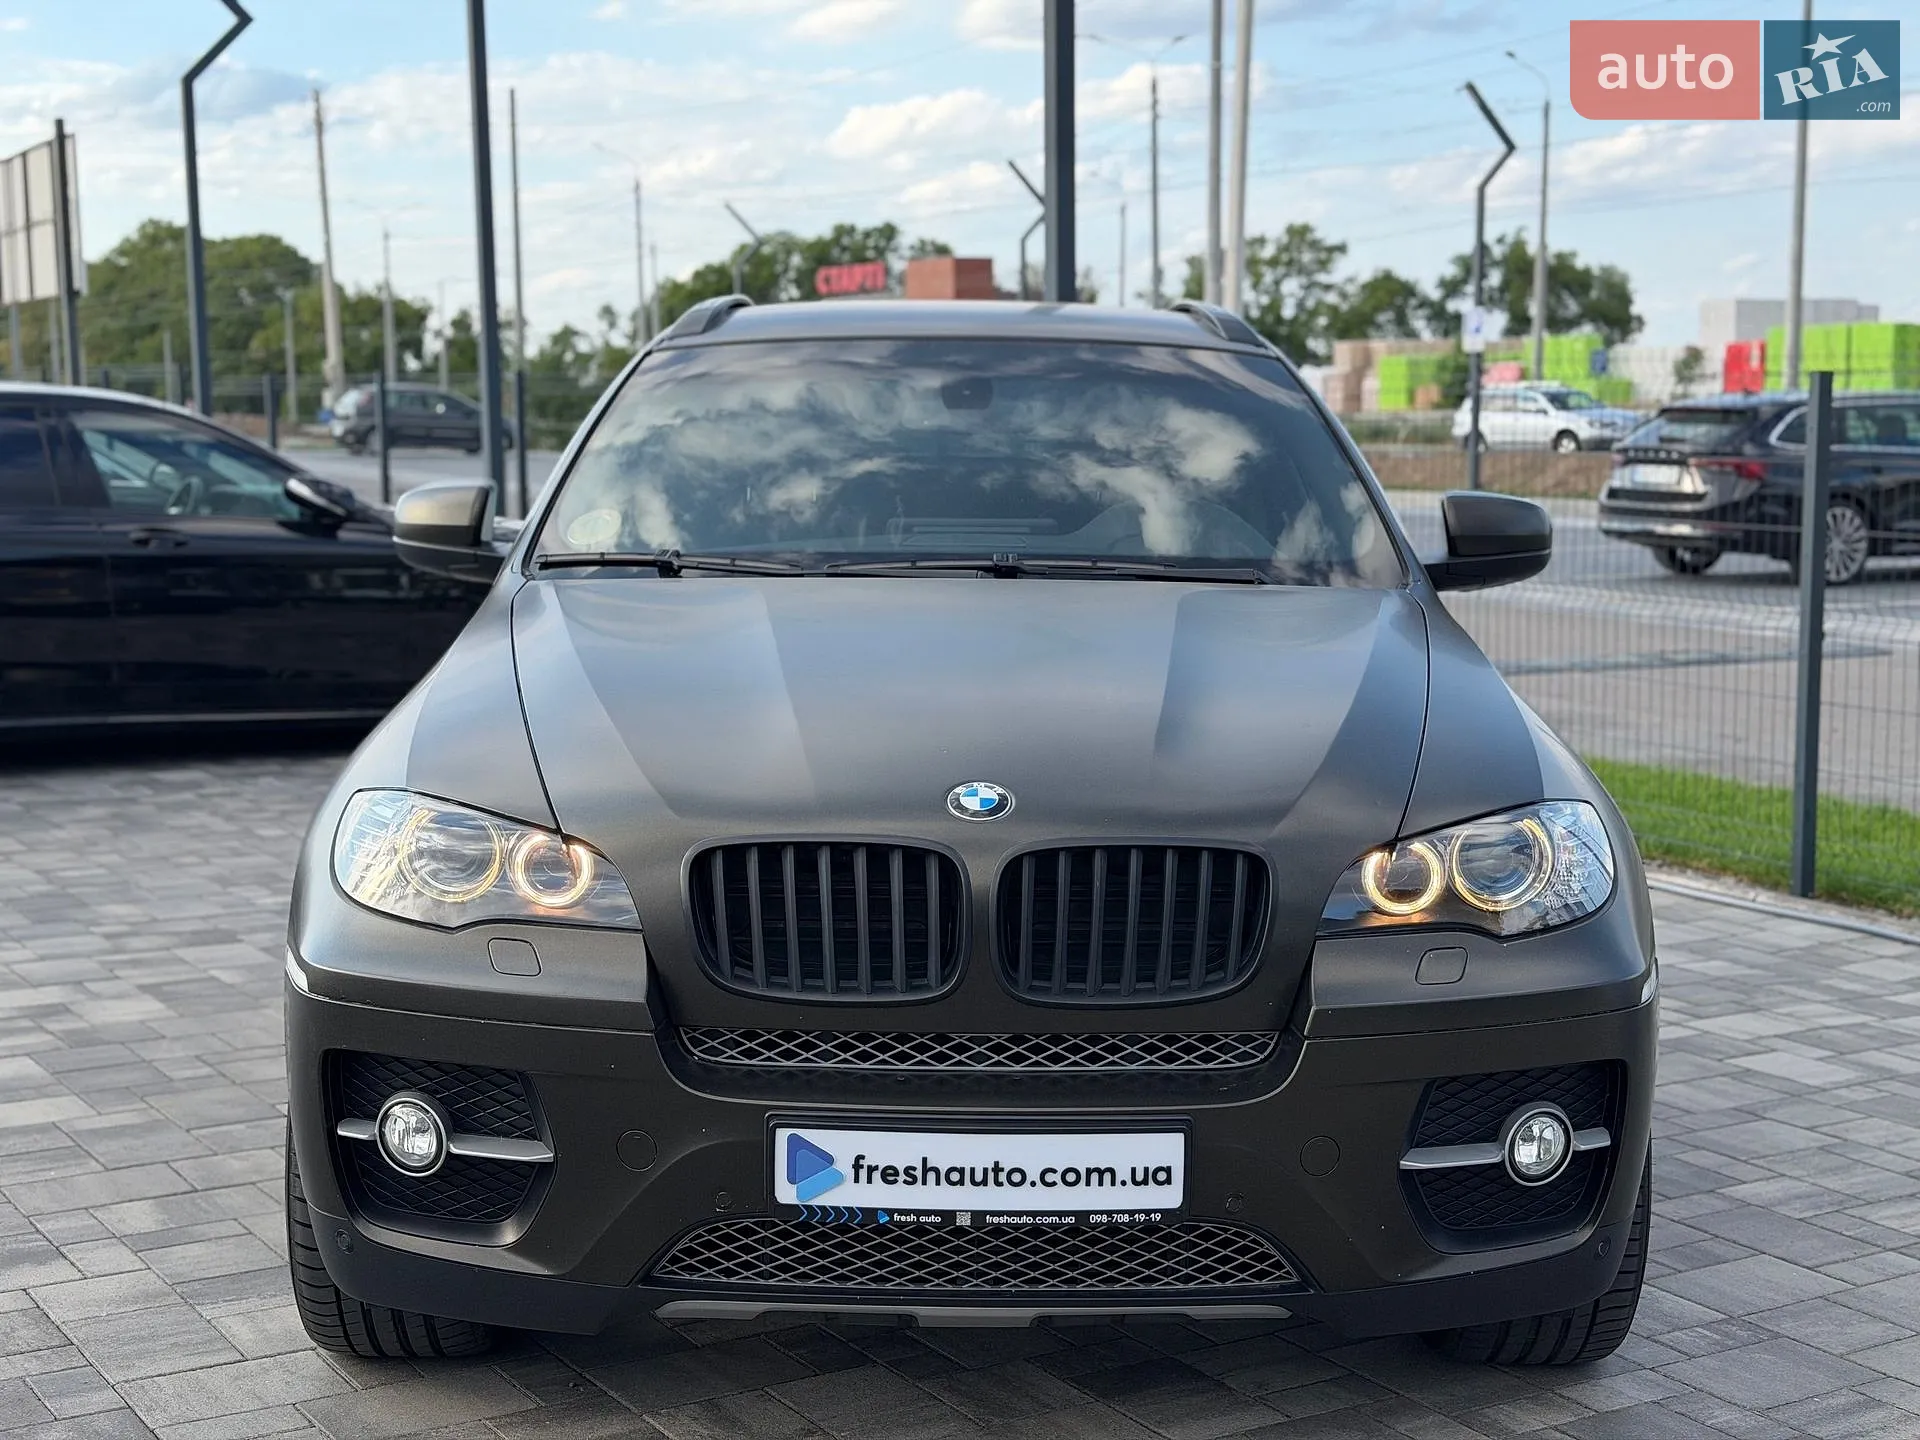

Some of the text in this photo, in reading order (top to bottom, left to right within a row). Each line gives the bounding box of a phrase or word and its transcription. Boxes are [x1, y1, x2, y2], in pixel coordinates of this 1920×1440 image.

[851, 1154, 1173, 1188] freshauto.com.ua
[893, 1212, 1162, 1224] fresh auto freshauto.com.ua 098-708-19-19
